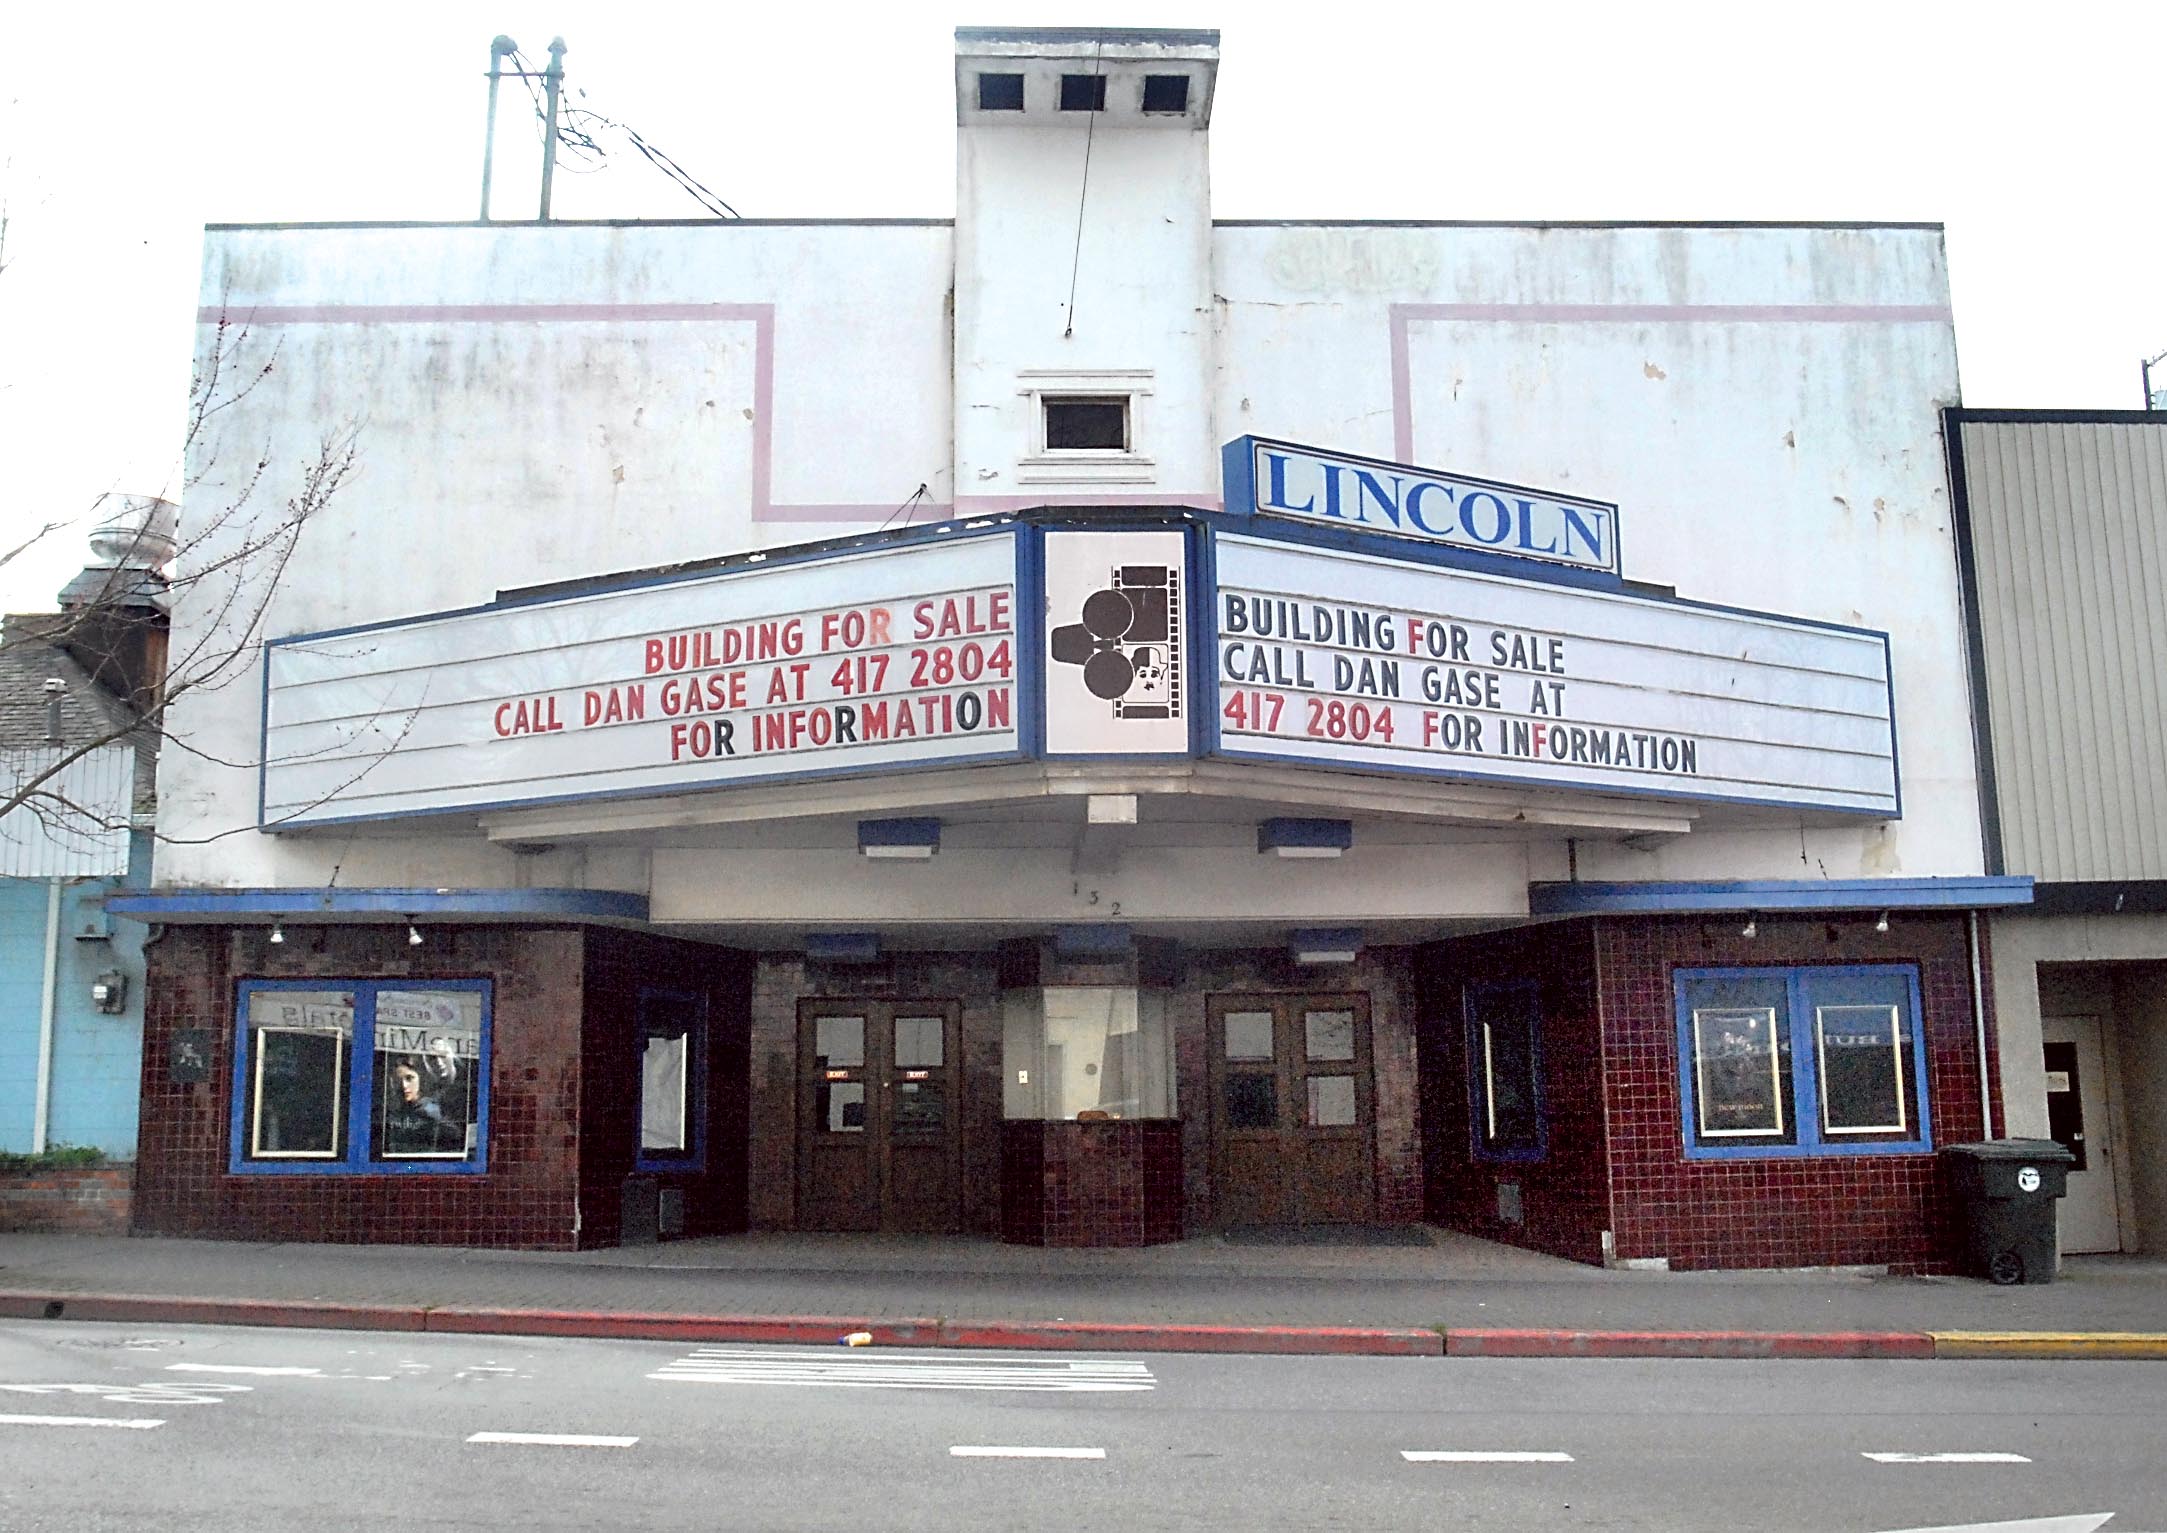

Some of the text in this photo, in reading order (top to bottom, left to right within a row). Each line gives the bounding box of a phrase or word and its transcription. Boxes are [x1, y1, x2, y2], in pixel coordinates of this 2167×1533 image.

[1267, 453, 1606, 562] LINCOLN
[644, 591, 1010, 675] BUILDING FOR SALE
[1225, 593, 1565, 675] BUILDING FOR SALE
[494, 639, 1013, 737] CALL DAN GASE AT 417 2804
[1223, 641, 1566, 717] CALL DAN GASE AT
[670, 687, 1010, 761] FOR INFORMATION
[1223, 689, 1698, 774] 417 2804 FOR INFORMATION
